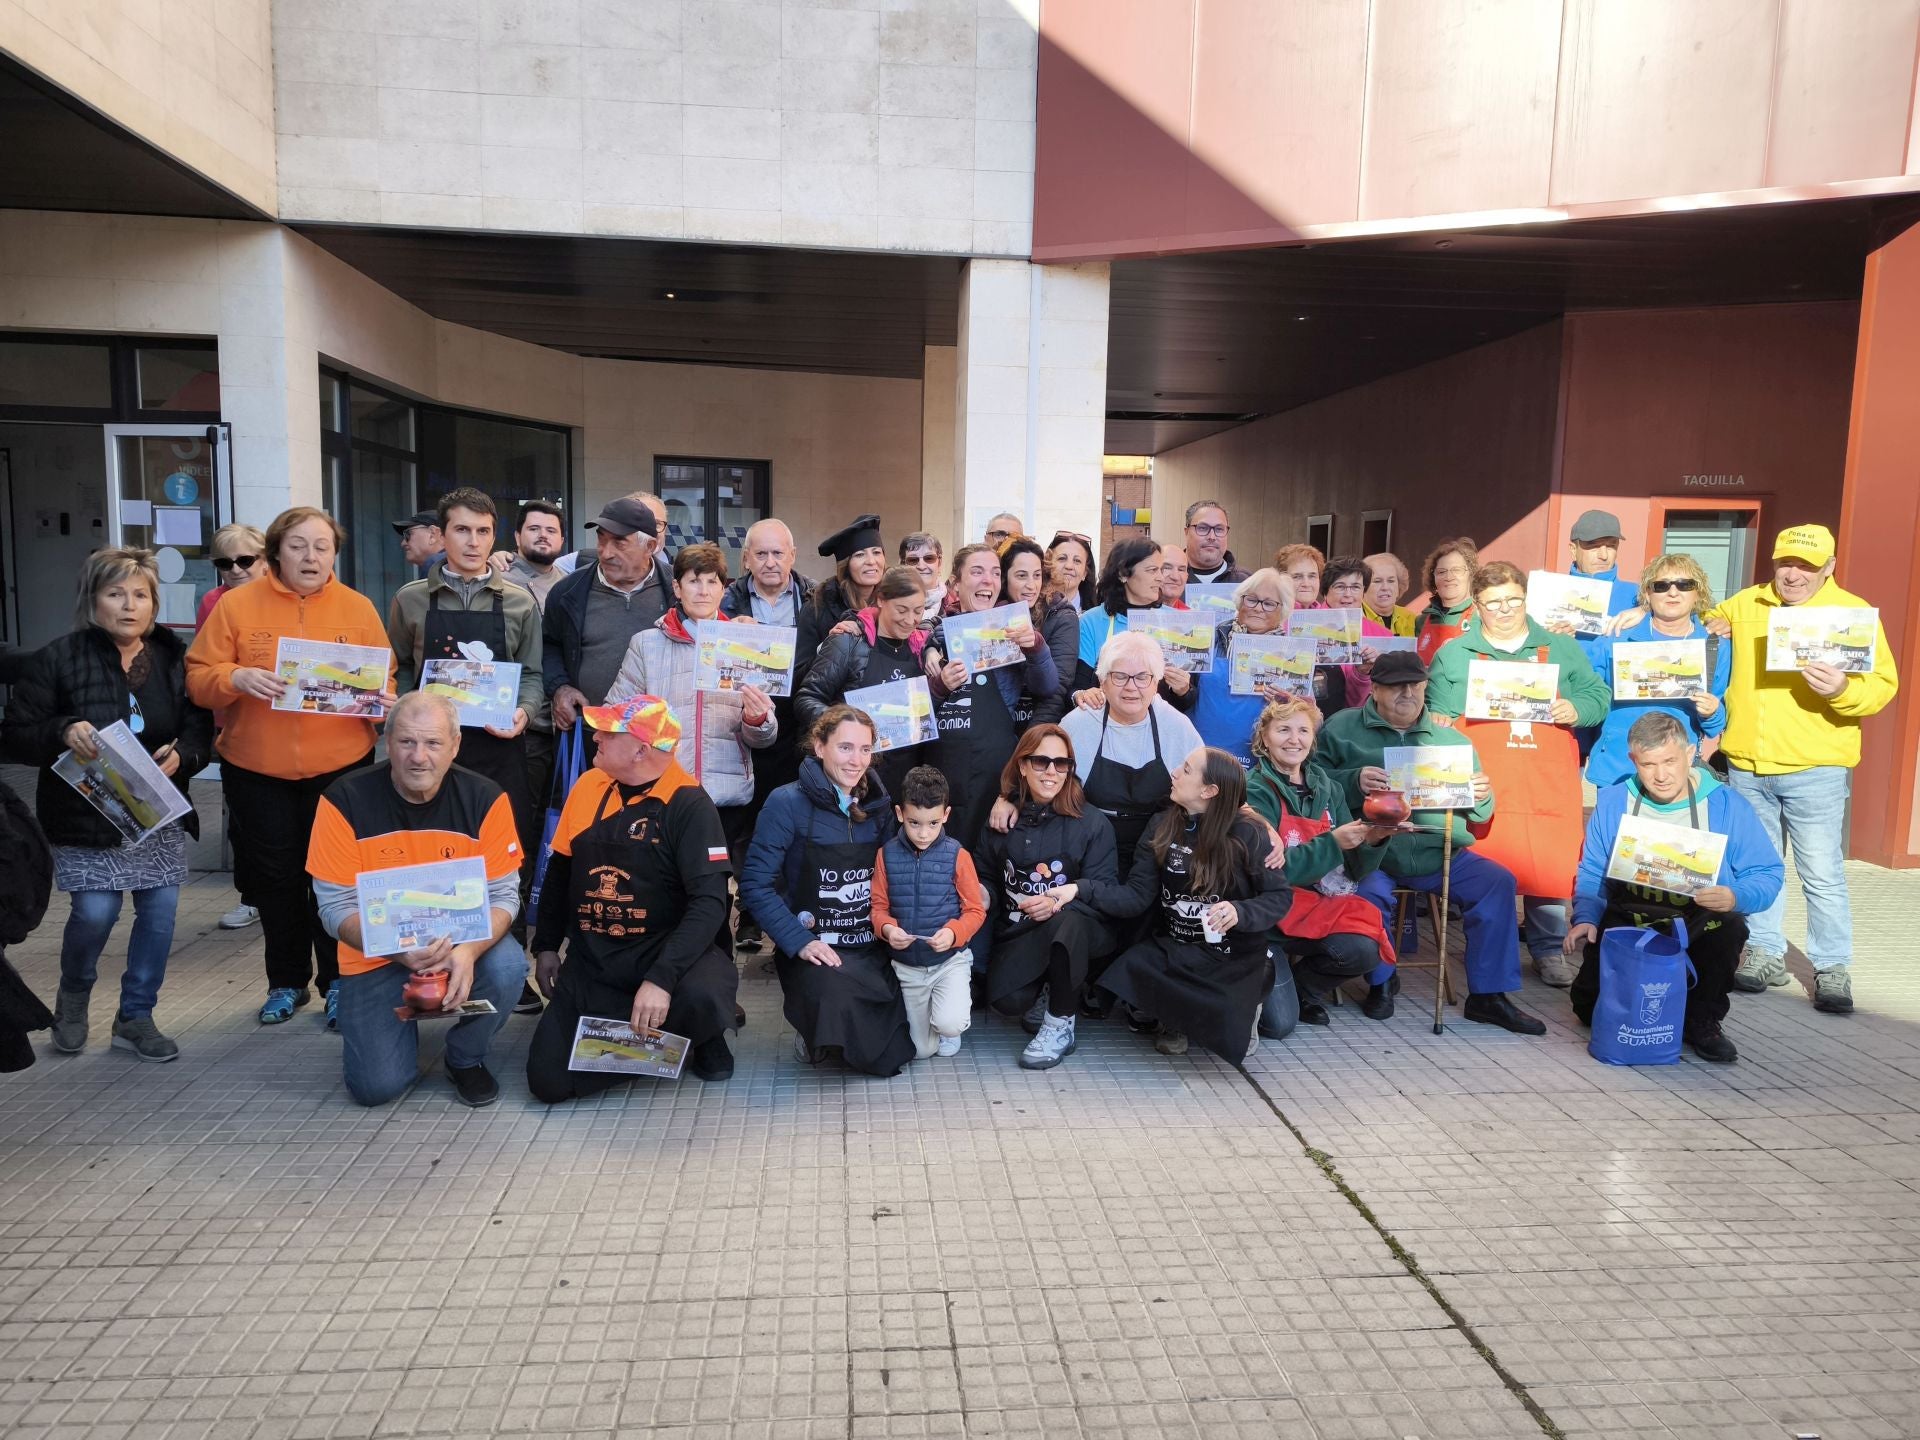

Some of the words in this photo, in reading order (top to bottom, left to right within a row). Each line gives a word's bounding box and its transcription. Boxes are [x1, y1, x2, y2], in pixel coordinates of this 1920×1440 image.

[1682, 474, 1745, 487] TAQUILLA
[282, 643, 300, 653] VIII
[1797, 649, 1825, 658] SEXT
[936, 717, 971, 730] OMIDA
[112, 727, 129, 745] VIII
[362, 877, 385, 889] VIII
[825, 918, 830, 926] a
[832, 918, 853, 927] veces
[1619, 1023, 1675, 1035] Ayuntamiento
[1616, 1034, 1674, 1047] GUARDO
[658, 1066, 675, 1075] VIII
